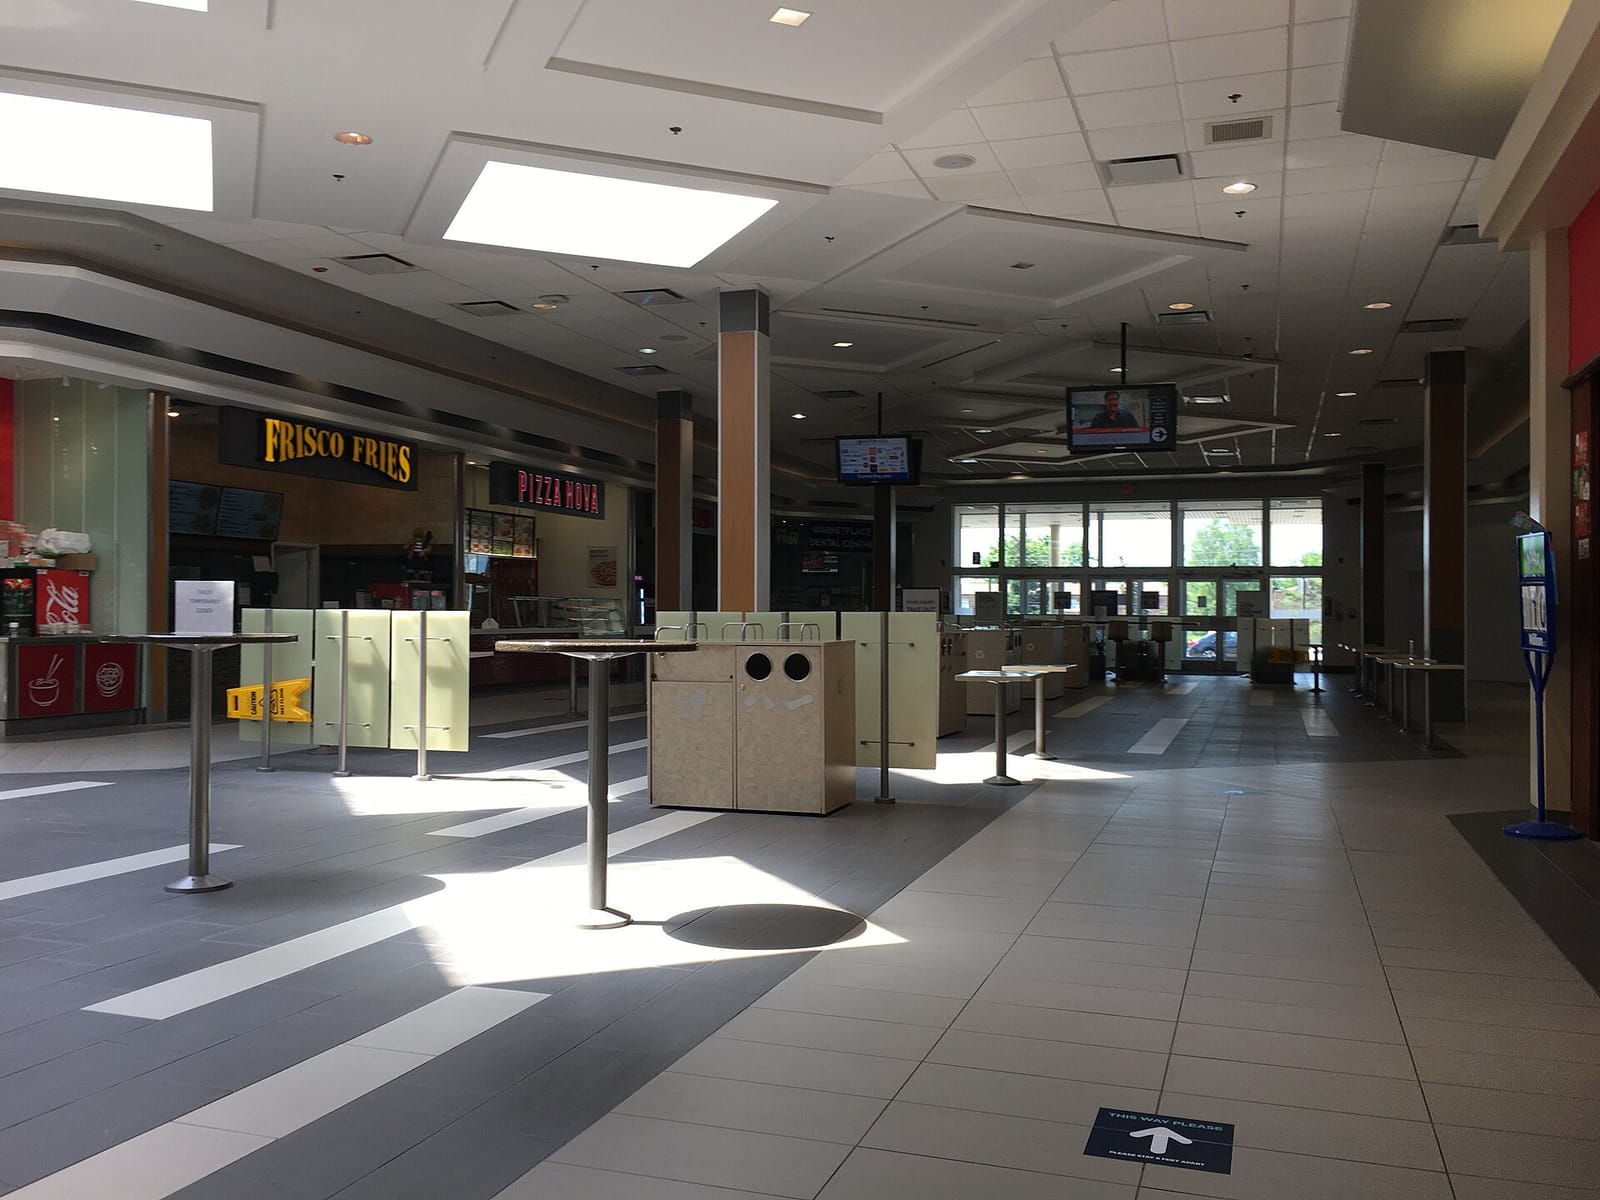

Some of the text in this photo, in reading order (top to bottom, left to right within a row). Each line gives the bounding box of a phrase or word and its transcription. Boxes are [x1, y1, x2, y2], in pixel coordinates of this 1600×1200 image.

[265, 418, 411, 483] FRISCO FRIES
[518, 470, 599, 514] PIZZA NOVA
[813, 526, 872, 536] MARKETPLACE
[809, 537, 841, 548] DENTAL
[1108, 1112, 1224, 1131] THIS WAY PLEASE
